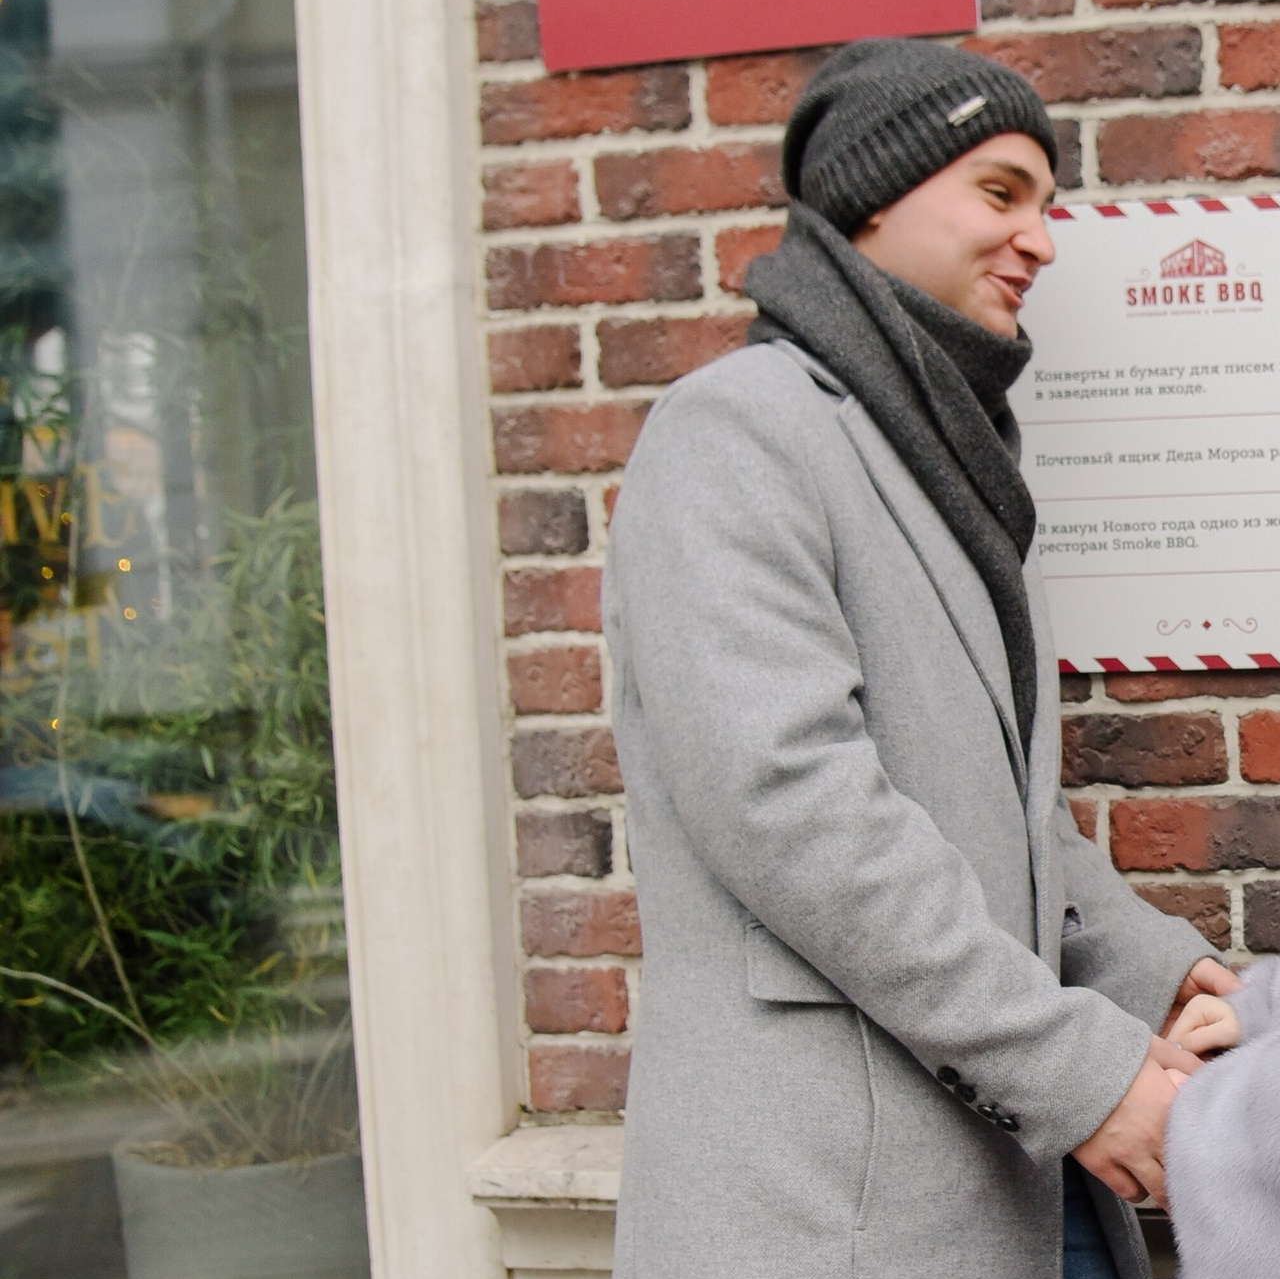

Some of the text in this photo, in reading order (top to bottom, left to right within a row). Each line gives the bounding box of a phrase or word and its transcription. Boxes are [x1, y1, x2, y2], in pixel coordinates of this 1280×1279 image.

[1126, 281, 1264, 306] SMOKE BBQ
[1034, 368, 1111, 385] Конверты
[1114, 368, 1125, 380] и
[1129, 365, 1186, 382] бумагу
[1189, 364, 1221, 377] для
[1224, 361, 1275, 374] писем
[1035, 383, 1208, 402] в заведении на входе.
[1035, 452, 1113, 468] Почтовый
[1118, 451, 1161, 466] ящик
[1165, 449, 1203, 464] Деда
[1207, 447, 1265, 463] Мороза
[1037, 523, 1047, 535] В
[1051, 521, 1099, 537] канун
[1102, 521, 1157, 534] Нового
[1161, 518, 1196, 532] года
[1199, 517, 1239, 530] одно
[1242, 517, 1261, 529] из
[1038, 535, 1200, 557] ресторан Smoke BBQ.
